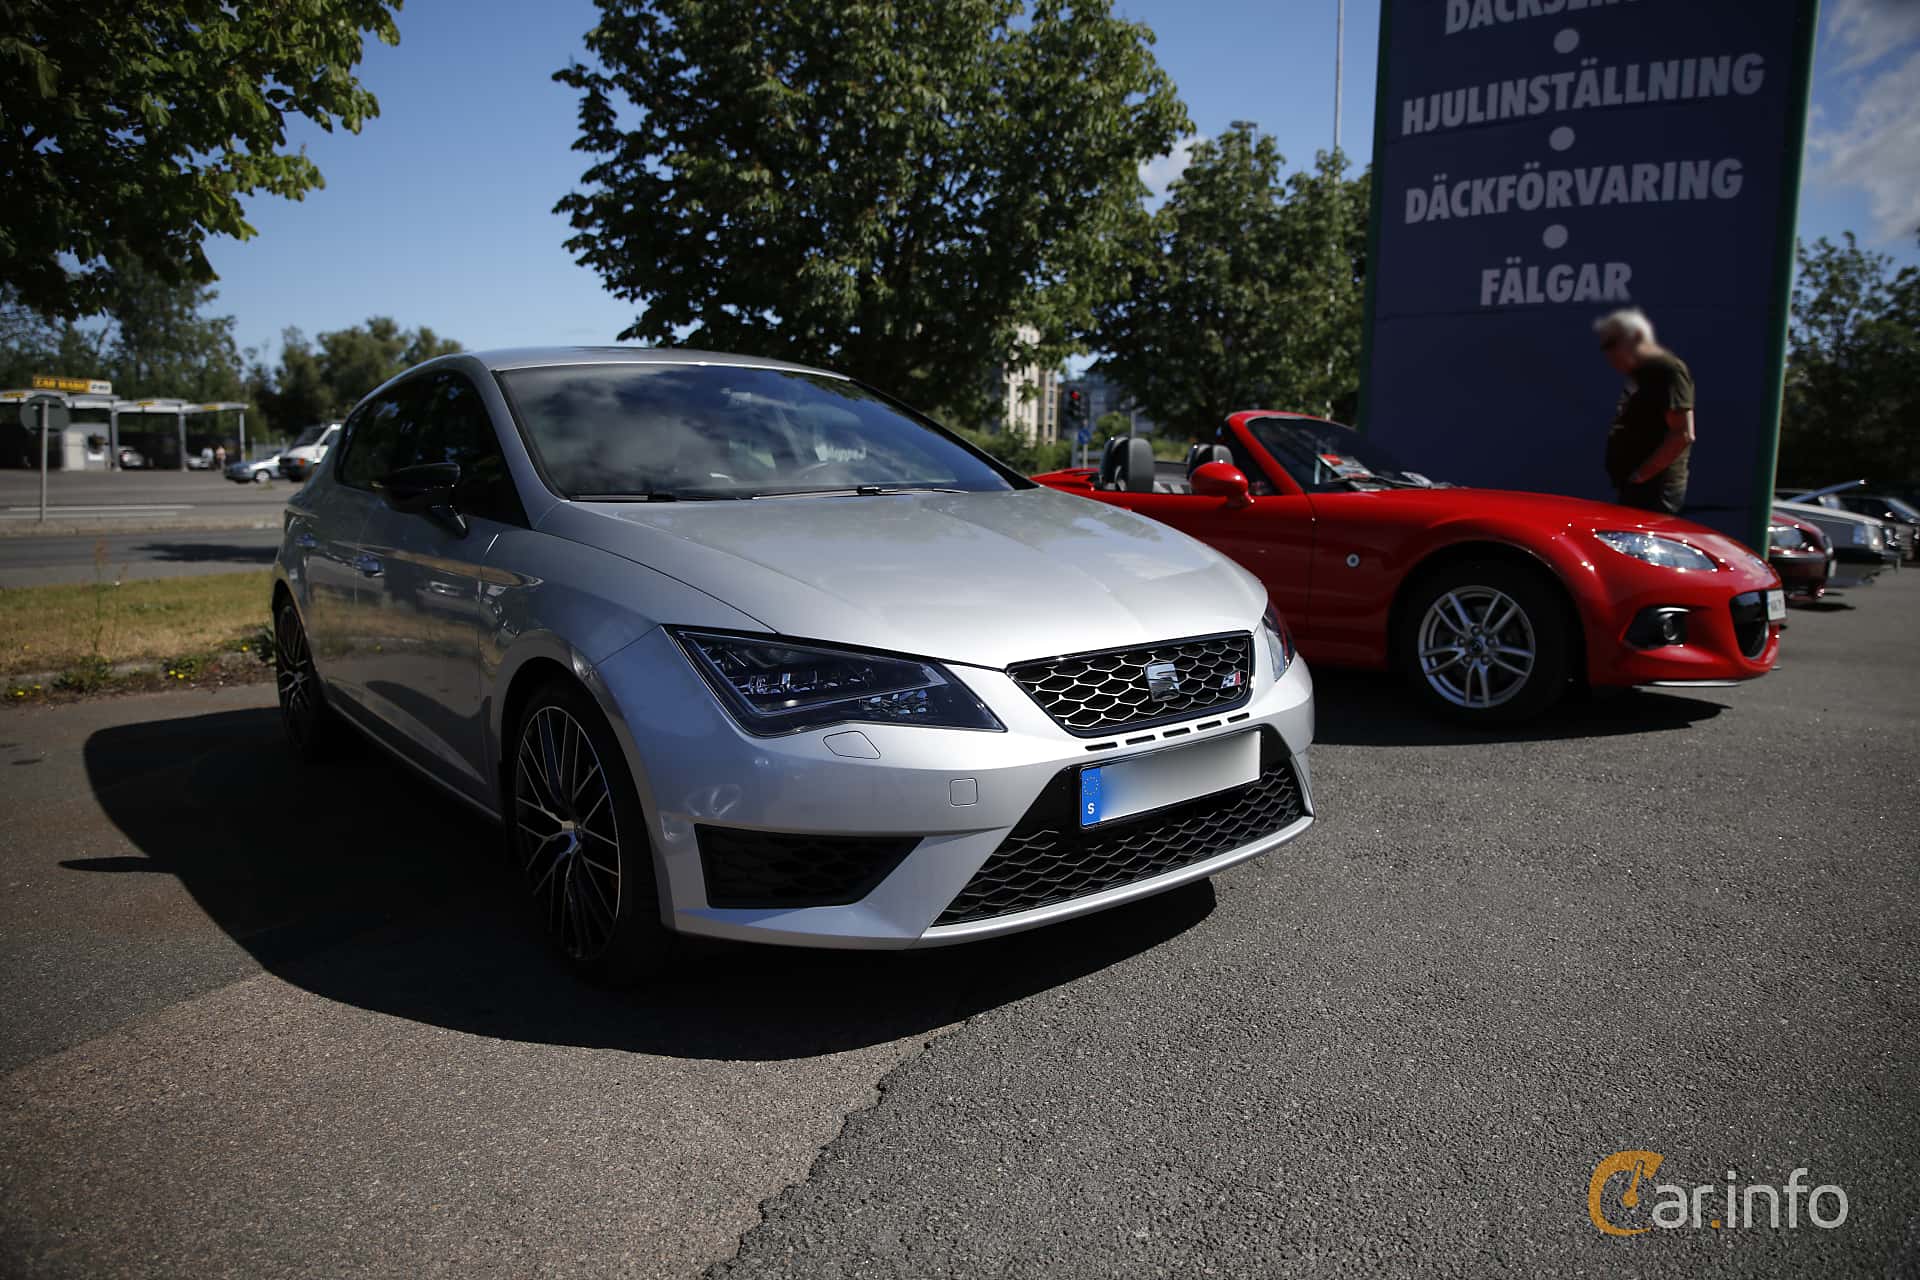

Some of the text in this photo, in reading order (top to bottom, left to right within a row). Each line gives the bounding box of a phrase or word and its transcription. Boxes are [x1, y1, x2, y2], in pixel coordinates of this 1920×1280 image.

[1402, 53, 1764, 135] HJULINSTÄLLNING
[1405, 159, 1743, 224] DÄCKFÖRVARING
[1480, 257, 1632, 306] FÄLGAR
[1087, 803, 1095, 815] S
